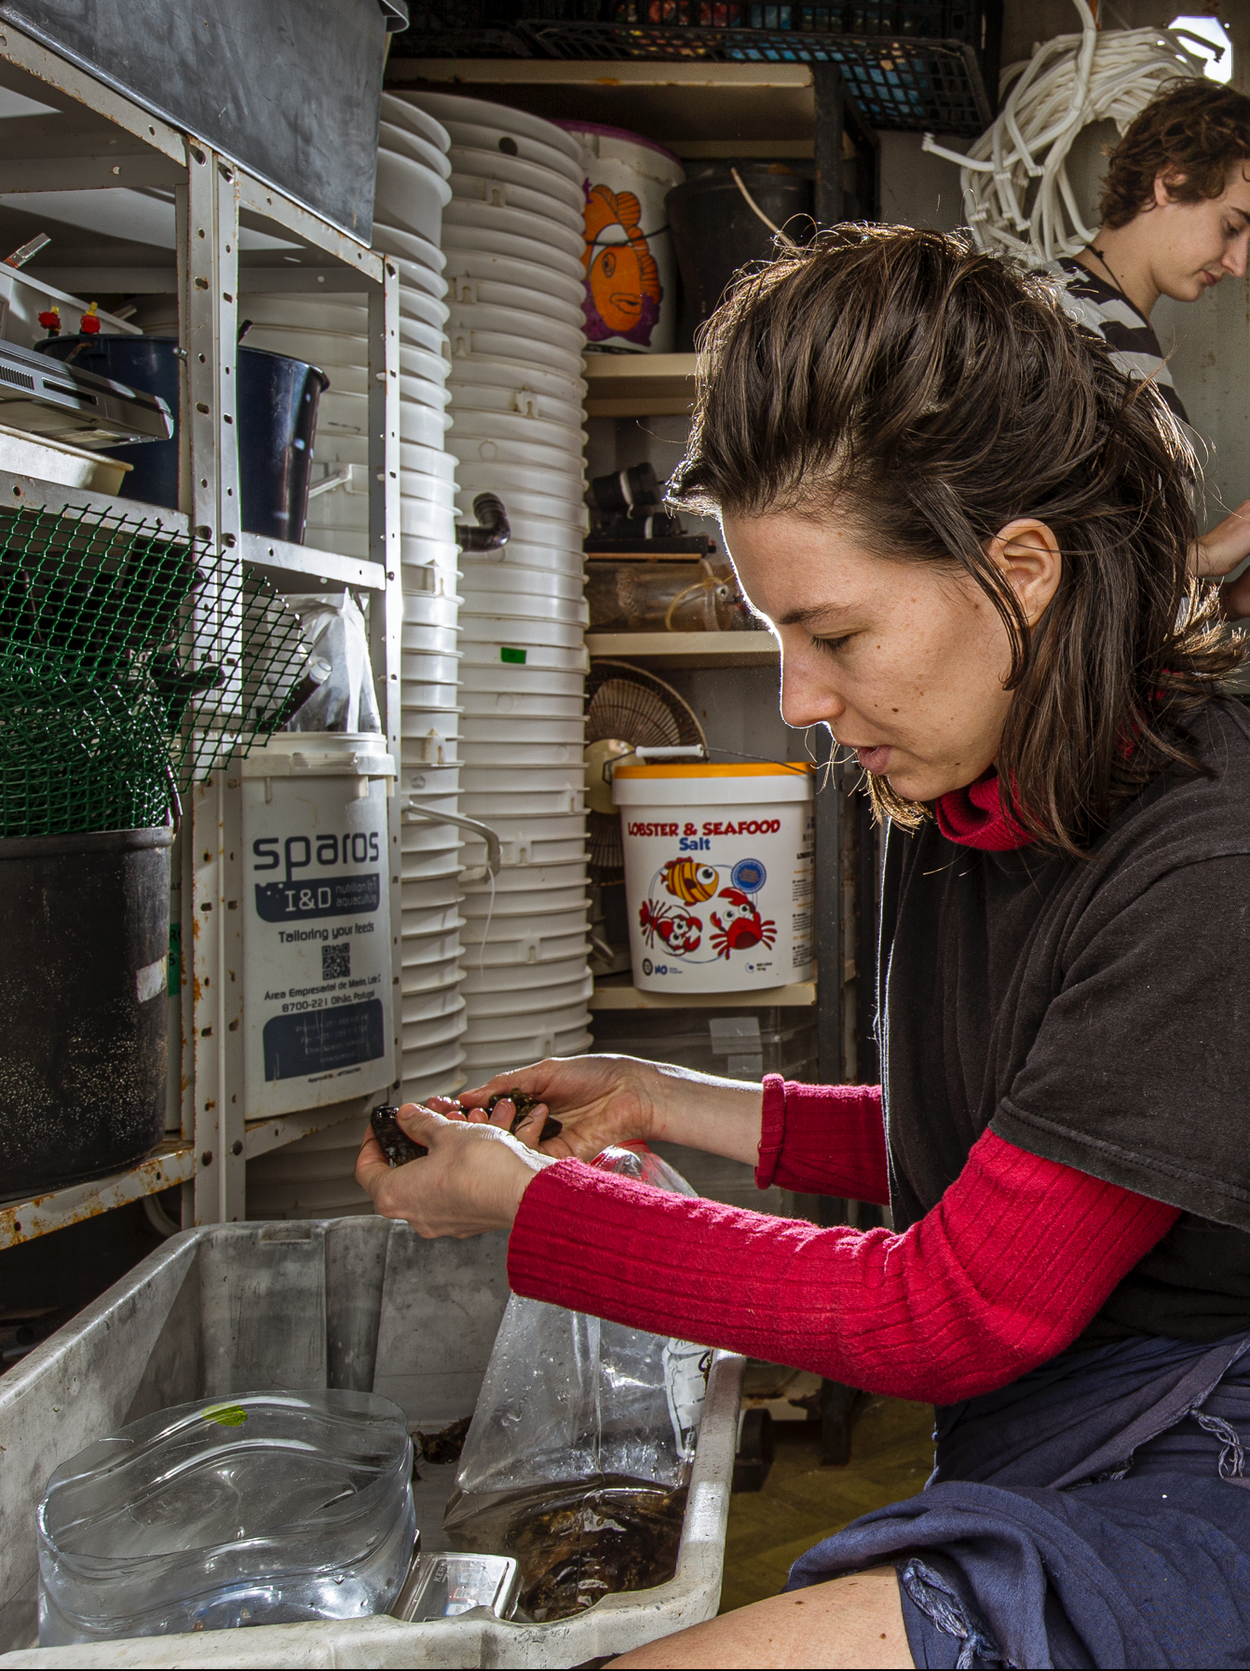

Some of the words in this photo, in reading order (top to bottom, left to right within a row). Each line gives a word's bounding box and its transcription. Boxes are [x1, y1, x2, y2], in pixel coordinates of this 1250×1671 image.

[628, 822, 680, 837] LOBSTER
[683, 822, 697, 836] &
[702, 819, 781, 836] SEAFOOD
[679, 837, 711, 851] Salt
[253, 831, 379, 880] sparos
[335, 881, 366, 894] nutrition
[284, 887, 332, 912] I&D
[278, 928, 329, 943] Tailoring
[332, 924, 353, 940] your
[355, 921, 375, 934] feeds
[264, 990, 287, 1001] Área
[289, 983, 336, 998] Empresarial
[338, 981, 348, 990] de
[282, 997, 328, 1013] 8700-221
